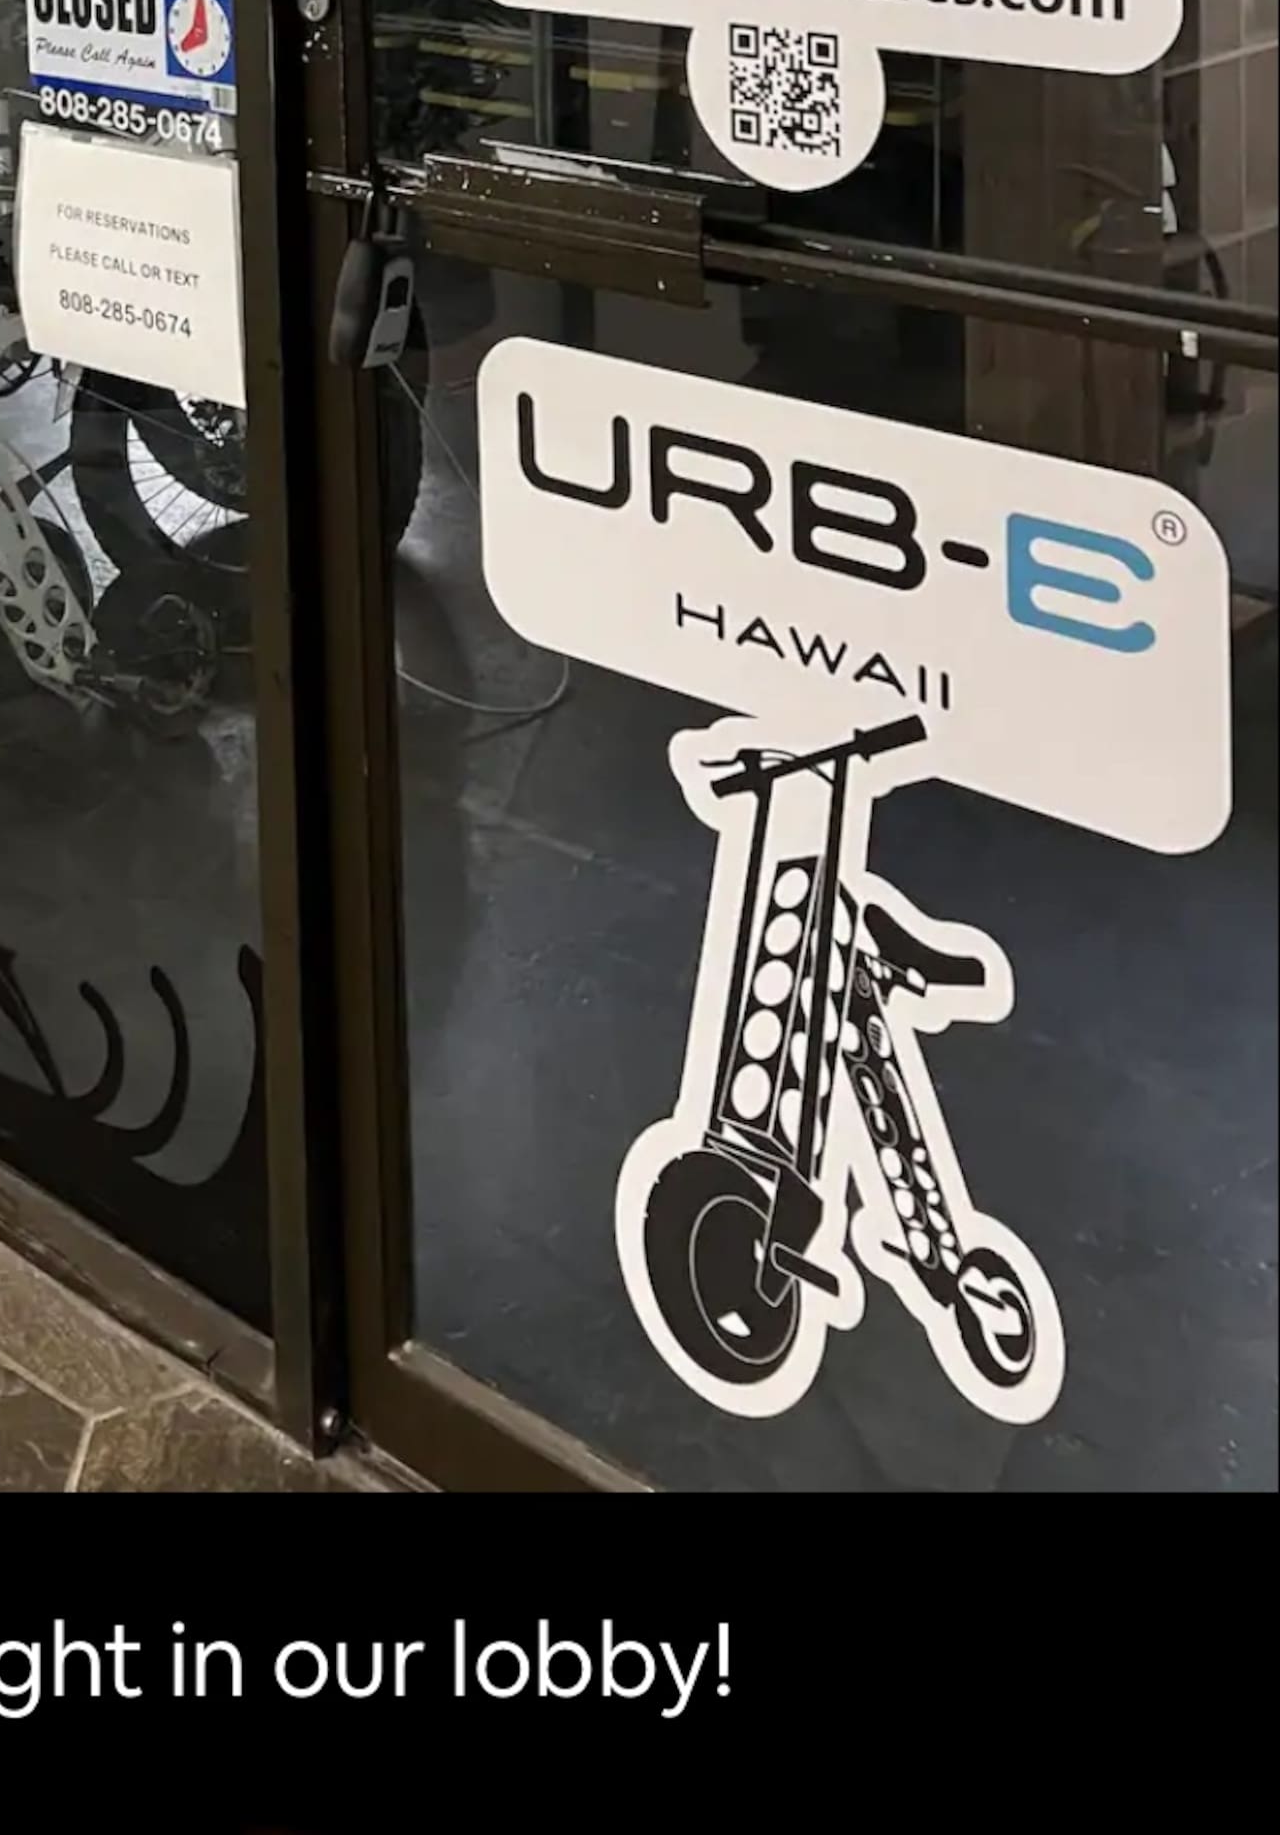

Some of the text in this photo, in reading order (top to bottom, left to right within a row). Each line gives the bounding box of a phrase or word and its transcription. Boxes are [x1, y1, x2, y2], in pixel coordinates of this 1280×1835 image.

[35, 37, 156, 72] Please Call Again
[39, 86, 222, 149] 808-285-0674
[56, 203, 191, 245] FOR RESERVATIONS
[49, 243, 201, 289] PLEASE CALL OR TEXT
[59, 288, 192, 338] 808-285-0674
[517, 392, 1156, 654] URB-E
[675, 592, 951, 711] HAWAII
